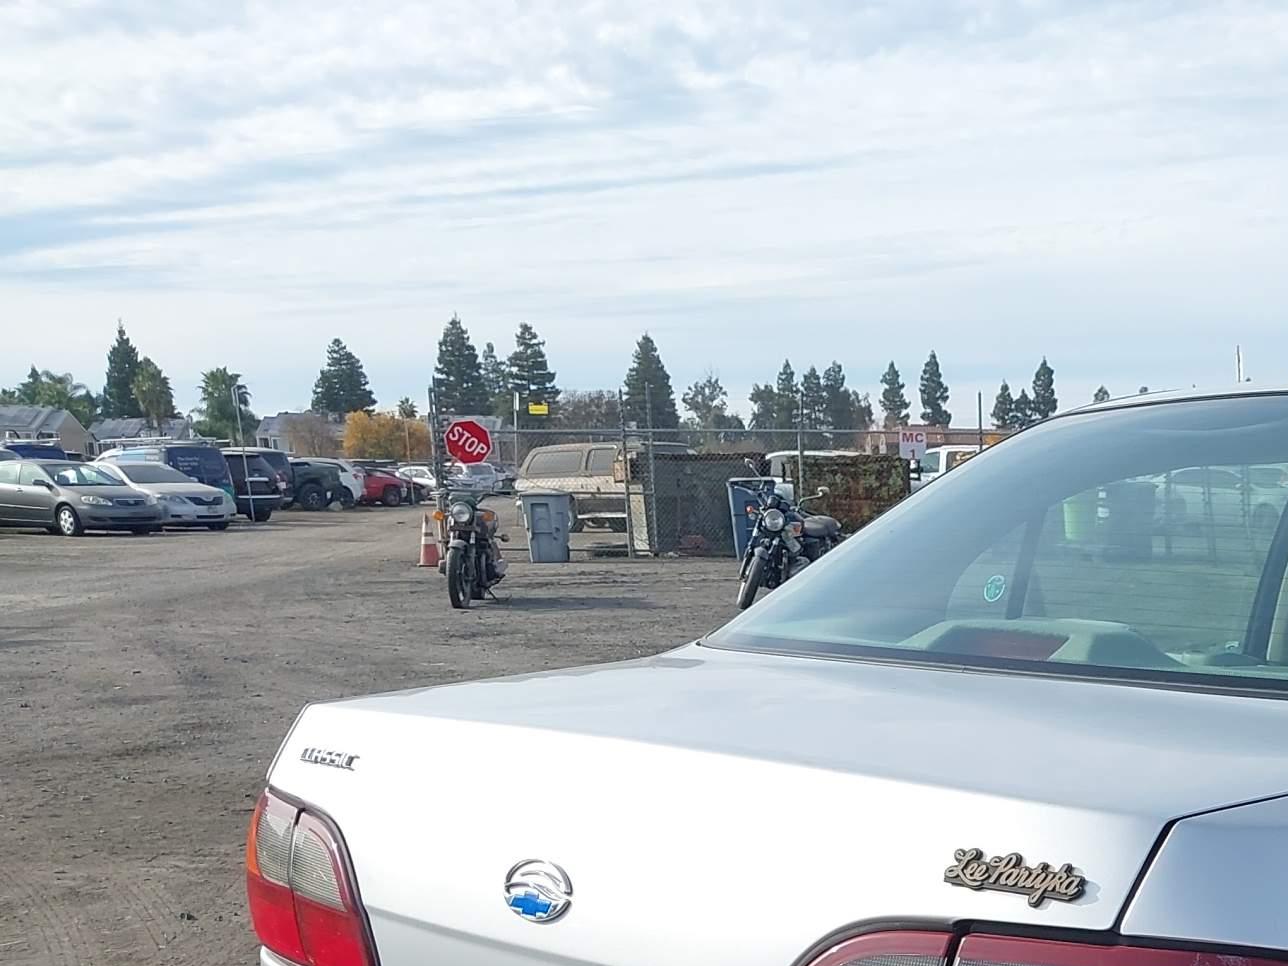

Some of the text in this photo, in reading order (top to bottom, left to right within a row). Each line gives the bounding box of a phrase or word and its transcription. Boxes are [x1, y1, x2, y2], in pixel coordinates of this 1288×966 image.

[449, 426, 488, 456] STOP
[902, 432, 924, 443] MC
[909, 449, 915, 459] 1
[299, 747, 360, 772] CLASSIC
[944, 849, 1081, 904] Lee Partyka
